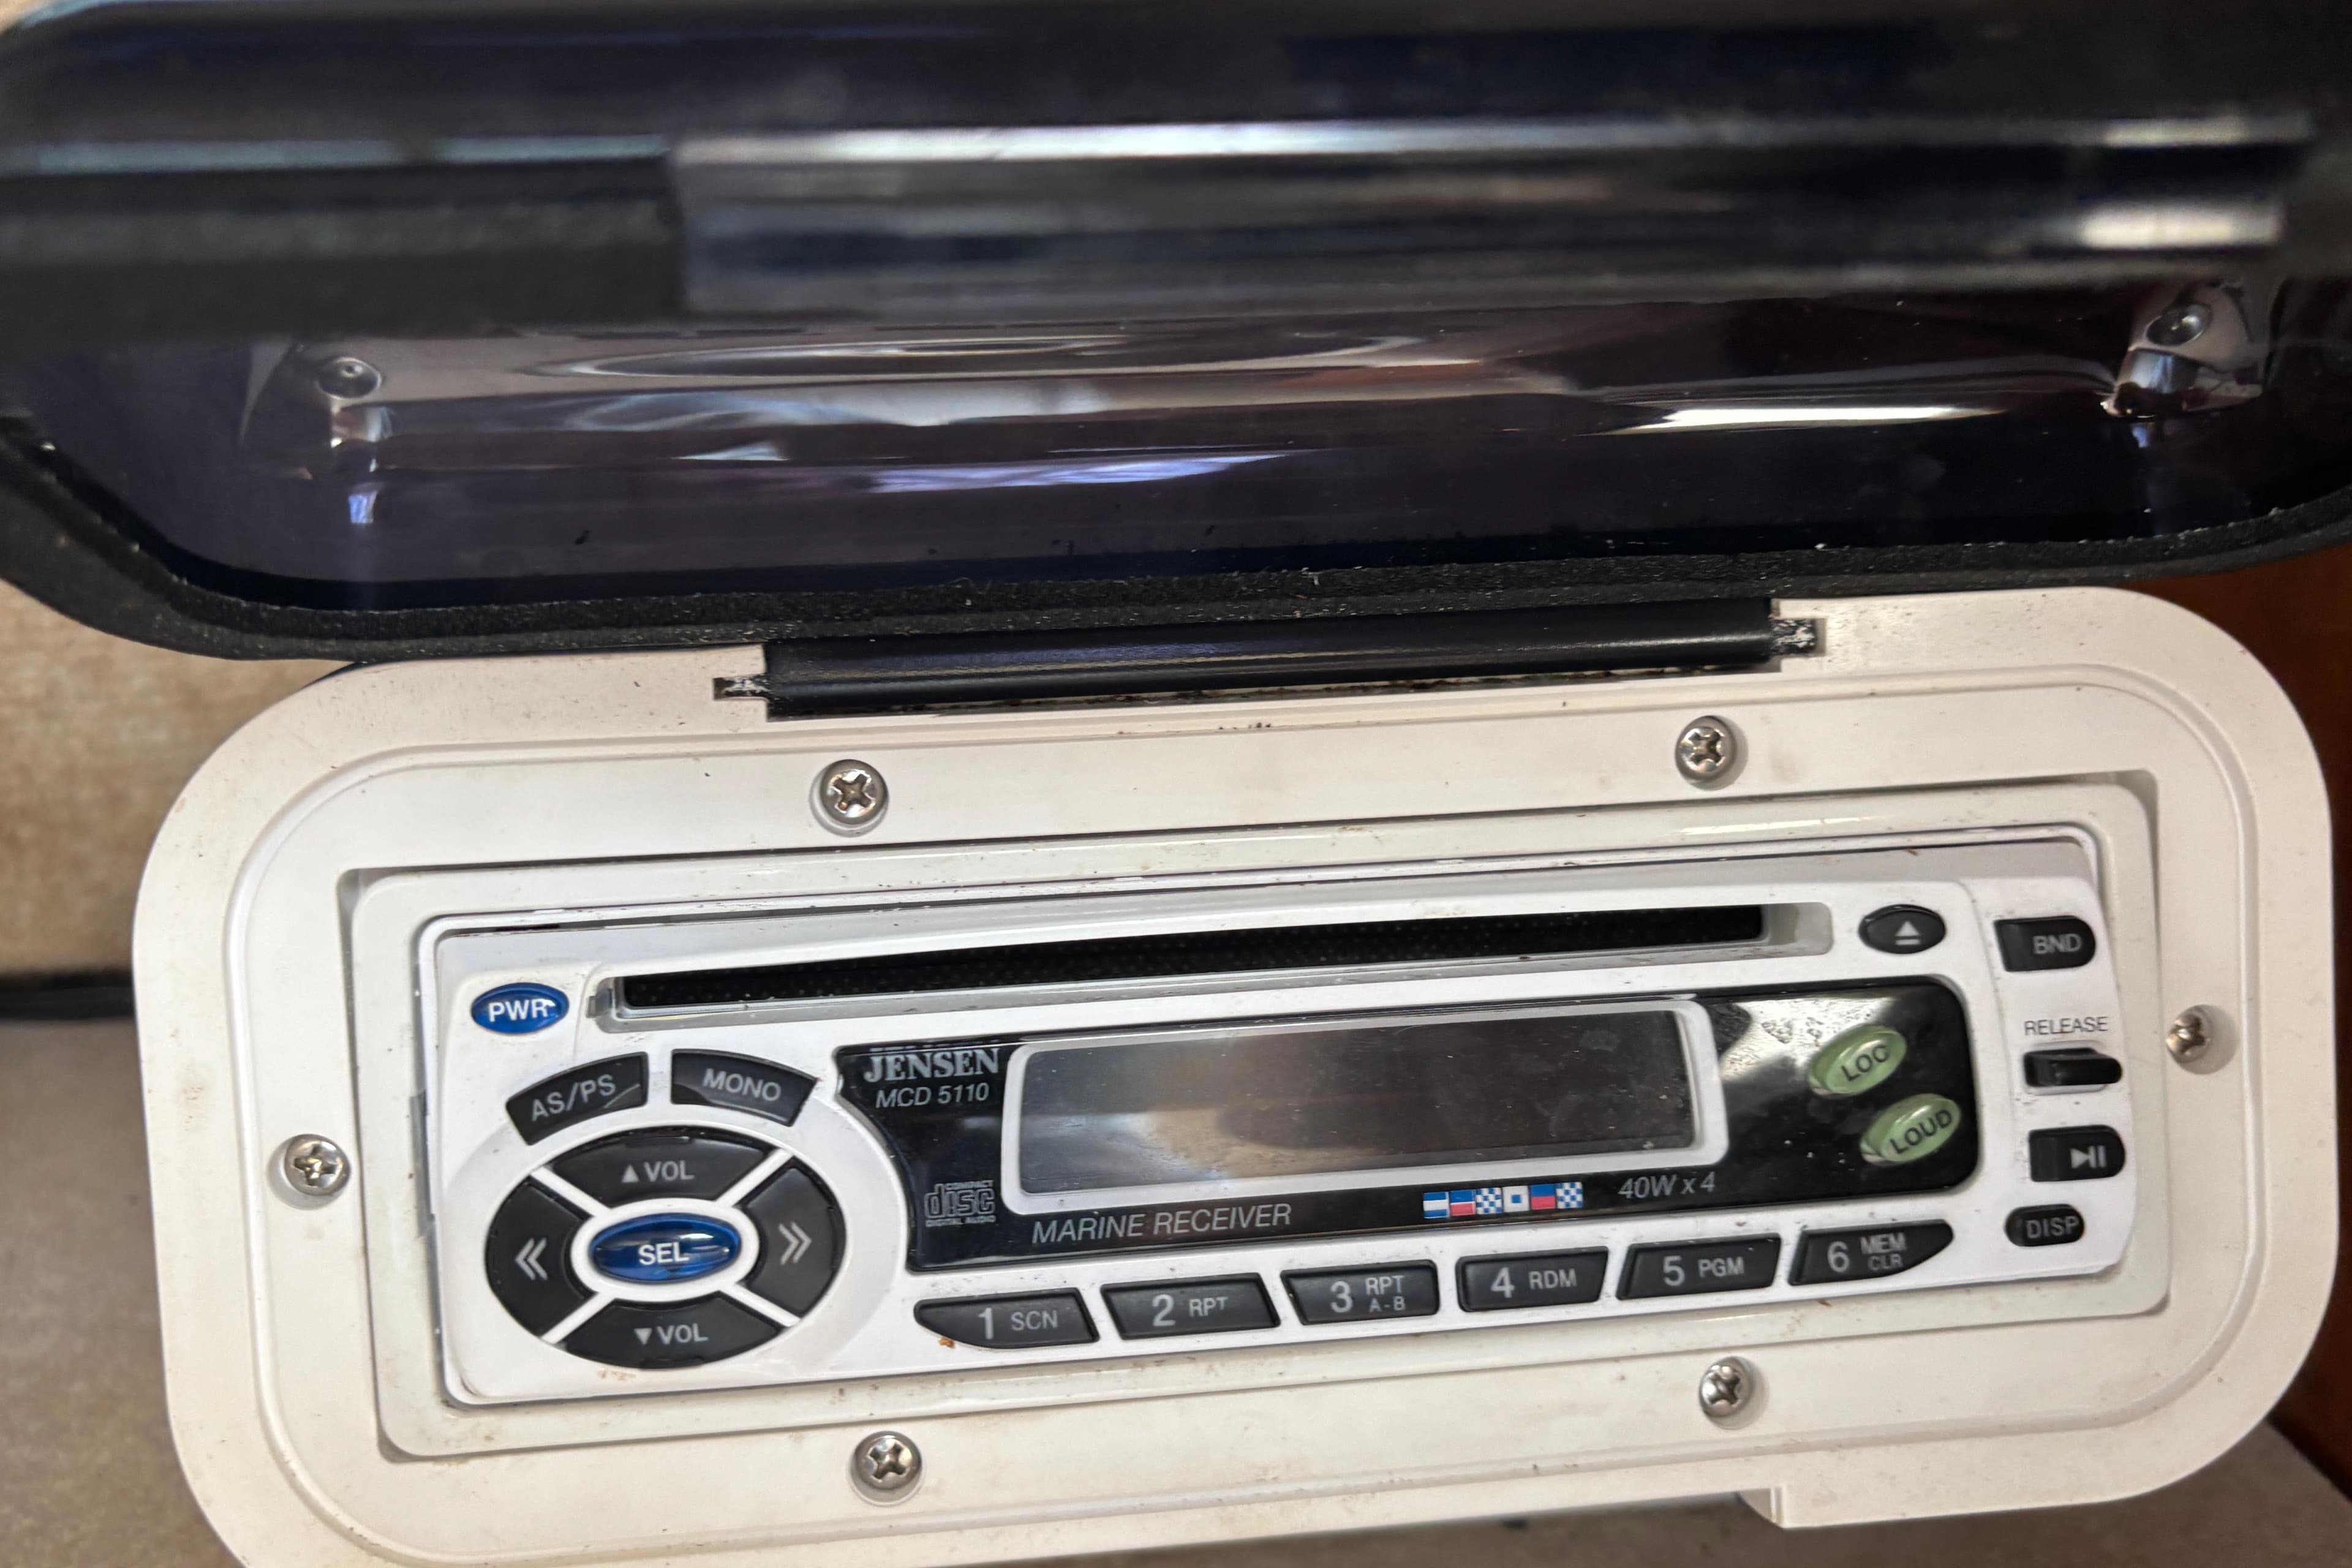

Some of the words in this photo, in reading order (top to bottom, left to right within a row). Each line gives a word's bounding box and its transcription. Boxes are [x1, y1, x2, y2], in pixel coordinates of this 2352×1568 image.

[2033, 932, 2082, 955] BND
[488, 1000, 552, 1022] PWR
[2024, 1016, 2109, 1036] RELEASE
[863, 1047, 1000, 1083] JENSEN
[1839, 1045, 1891, 1083] LOC
[530, 1074, 617, 1121] AS/PS
[703, 1068, 781, 1101] MONO
[875, 1086, 931, 1108] MCD
[937, 1083, 990, 1104] 5110
[1890, 1109, 1953, 1156] LOUD
[644, 1160, 695, 1182] VOL
[1618, 1177, 1678, 1199] 40W
[1697, 1172, 1716, 1193] 4
[1031, 1213, 1145, 1244] MARINE
[1152, 1203, 1293, 1235] RECEIVER
[2026, 1218, 2079, 1240] DISP
[638, 1242, 688, 1266] SEL
[1826, 1242, 1850, 1273] 6
[1860, 1234, 1907, 1254] MEM
[1867, 1253, 1903, 1272] CLR
[1490, 1267, 1515, 1298] 4
[1528, 1270, 1577, 1289] RDM
[1662, 1255, 1685, 1286] 5
[1697, 1257, 1746, 1279] PGM
[1330, 1280, 1354, 1313] 3
[1365, 1275, 1404, 1295] RPT
[978, 1307, 995, 1340] 1
[1010, 1310, 1059, 1332] SCN
[1152, 1294, 1177, 1327] 2
[1188, 1295, 1229, 1317] RPT
[658, 1325, 709, 1345] VOL
